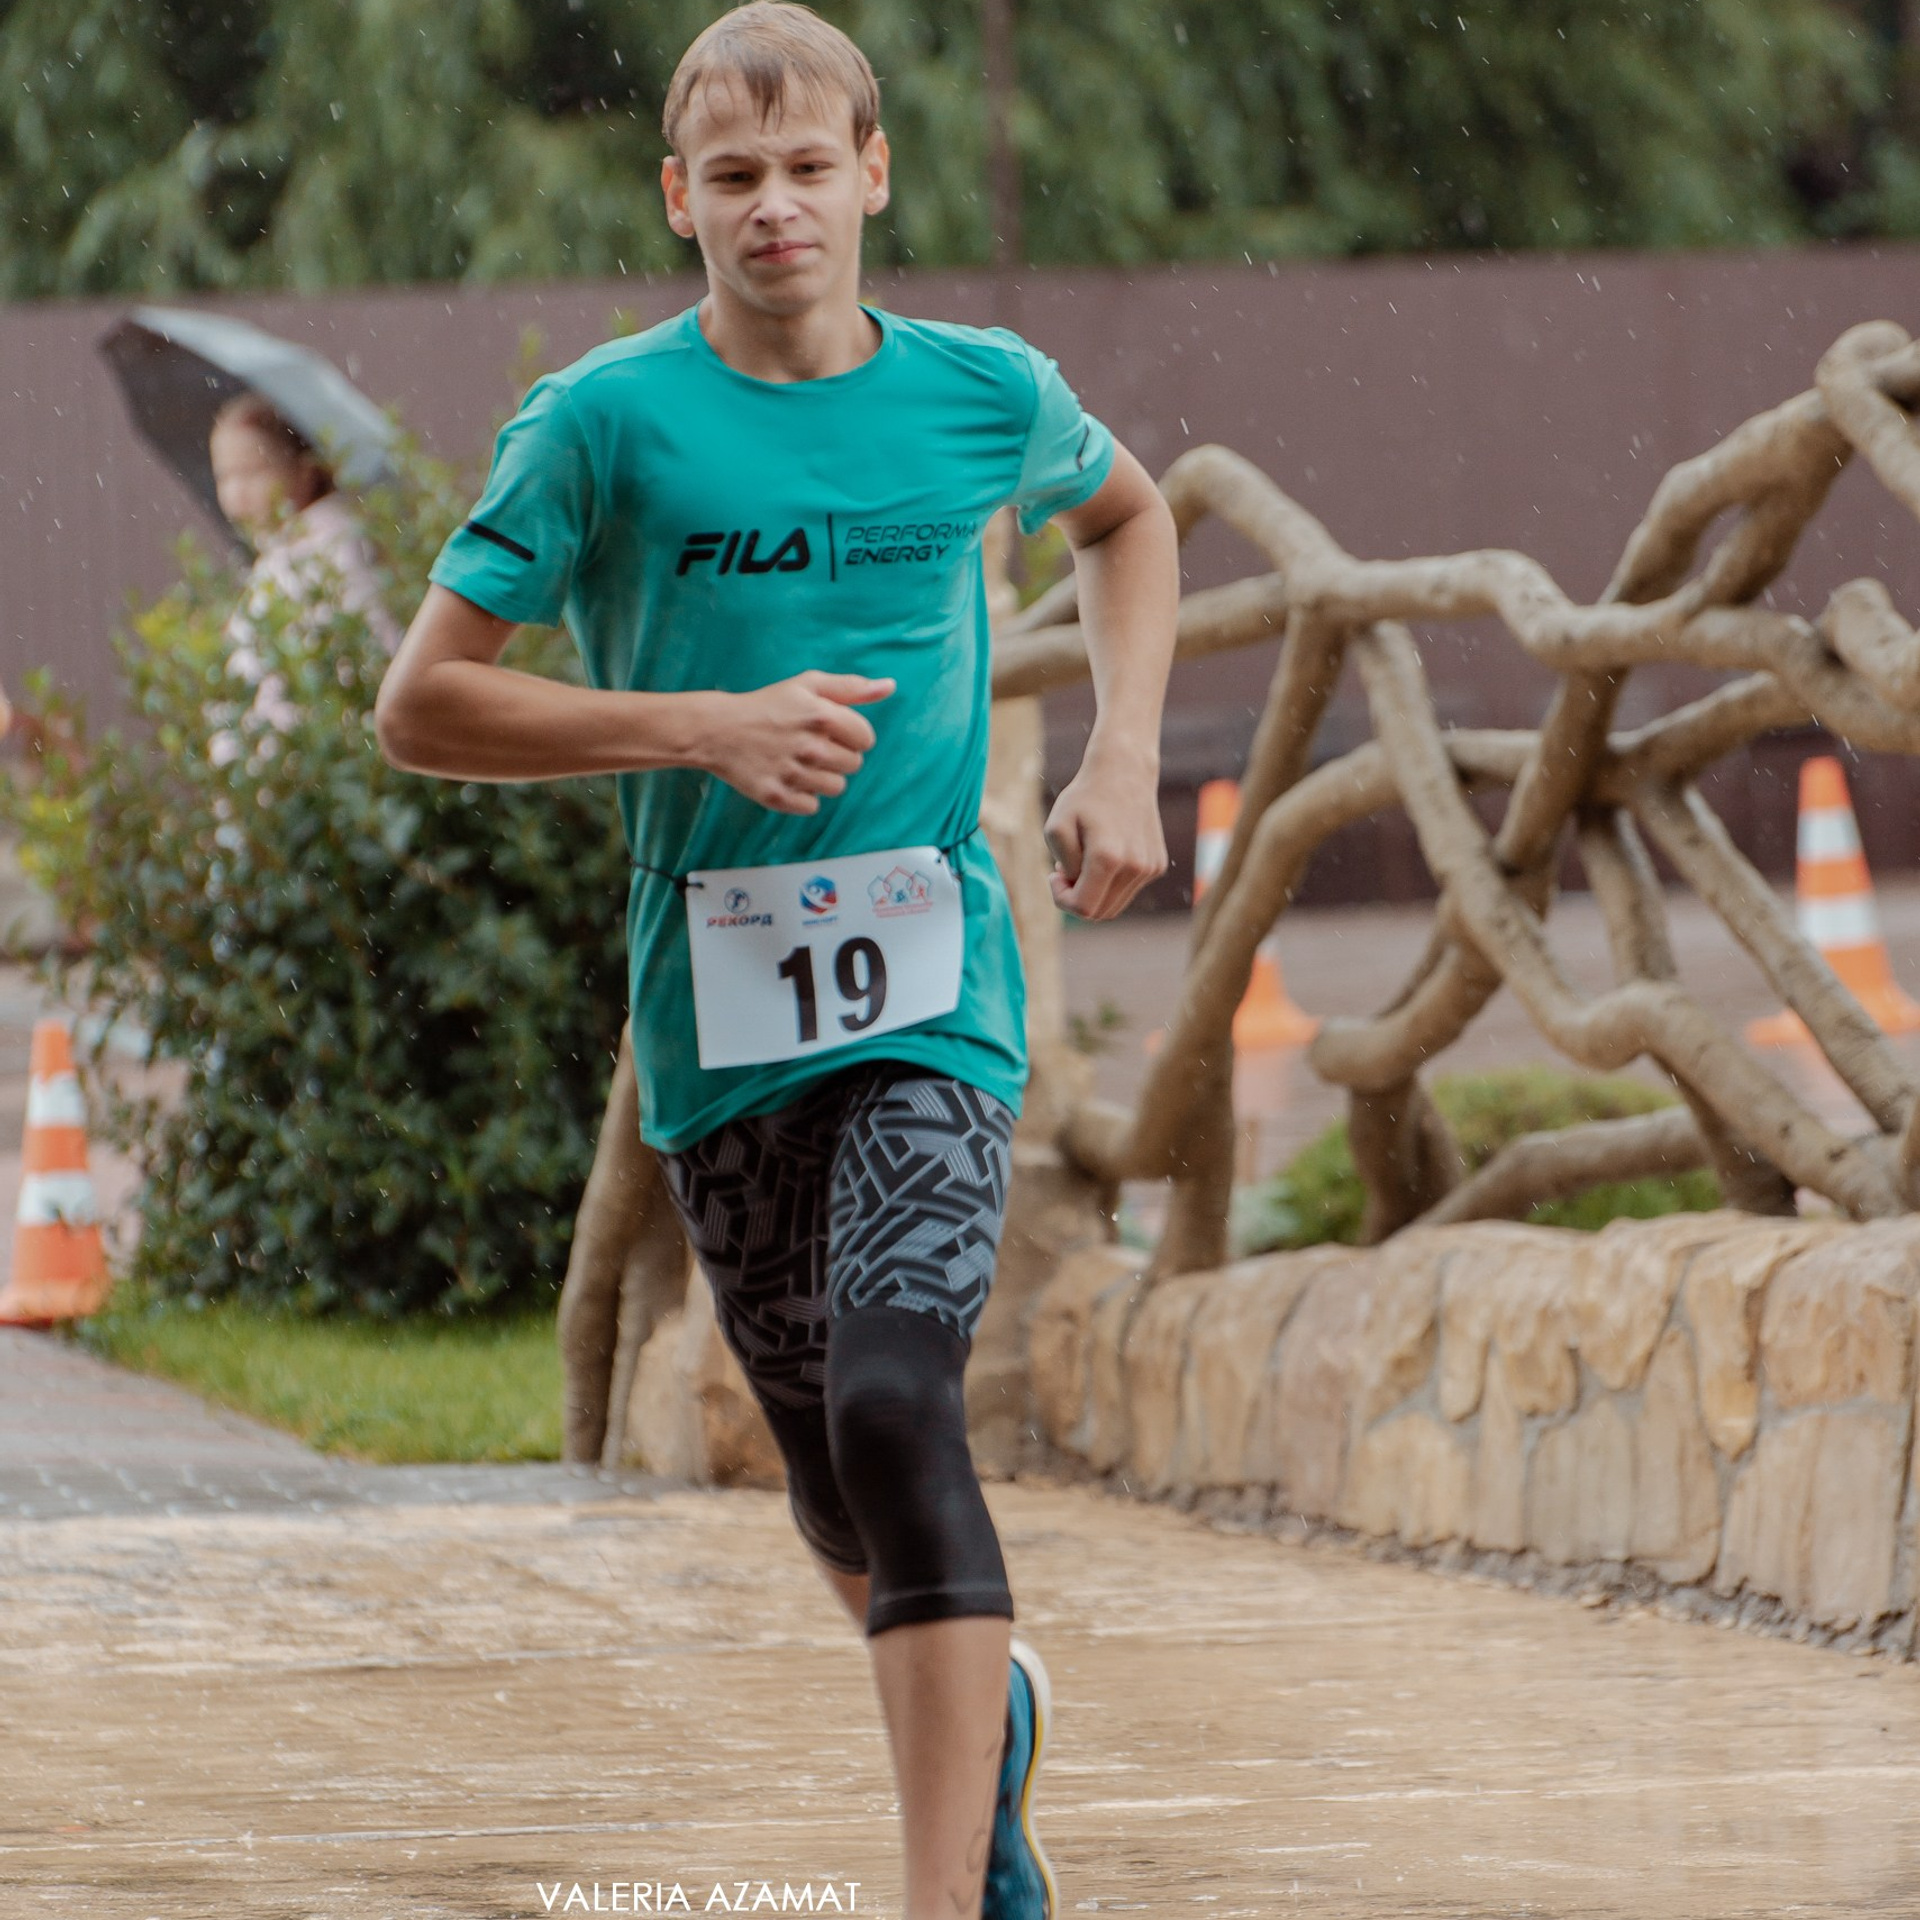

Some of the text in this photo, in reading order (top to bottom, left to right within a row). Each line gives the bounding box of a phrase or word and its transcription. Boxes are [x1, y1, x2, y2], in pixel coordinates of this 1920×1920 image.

[675, 527, 811, 576] FILA
[844, 544, 950, 565] ENERGY
[777, 936, 887, 1043] 19
